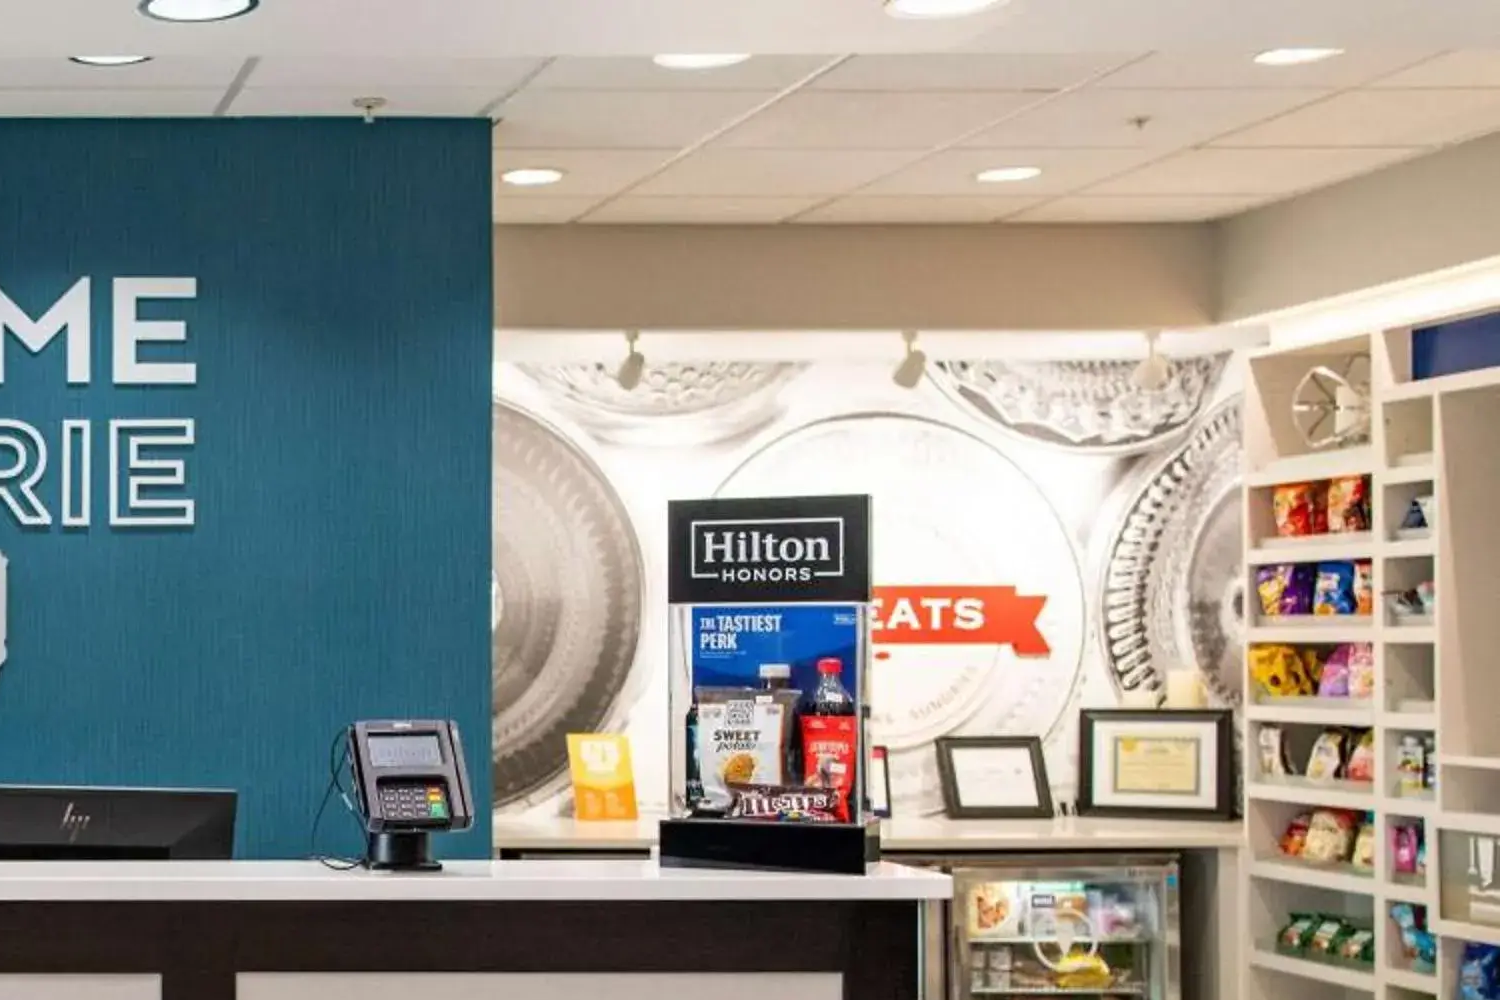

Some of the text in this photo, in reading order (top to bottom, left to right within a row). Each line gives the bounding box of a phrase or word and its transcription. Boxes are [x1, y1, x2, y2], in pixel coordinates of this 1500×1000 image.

[703, 530, 831, 563] Hilton
[722, 567, 811, 582] HONORS
[717, 613, 782, 632] TASTIEST
[699, 632, 738, 650] PERK
[713, 729, 761, 741] SWEET
[59, 802, 91, 843] hp
